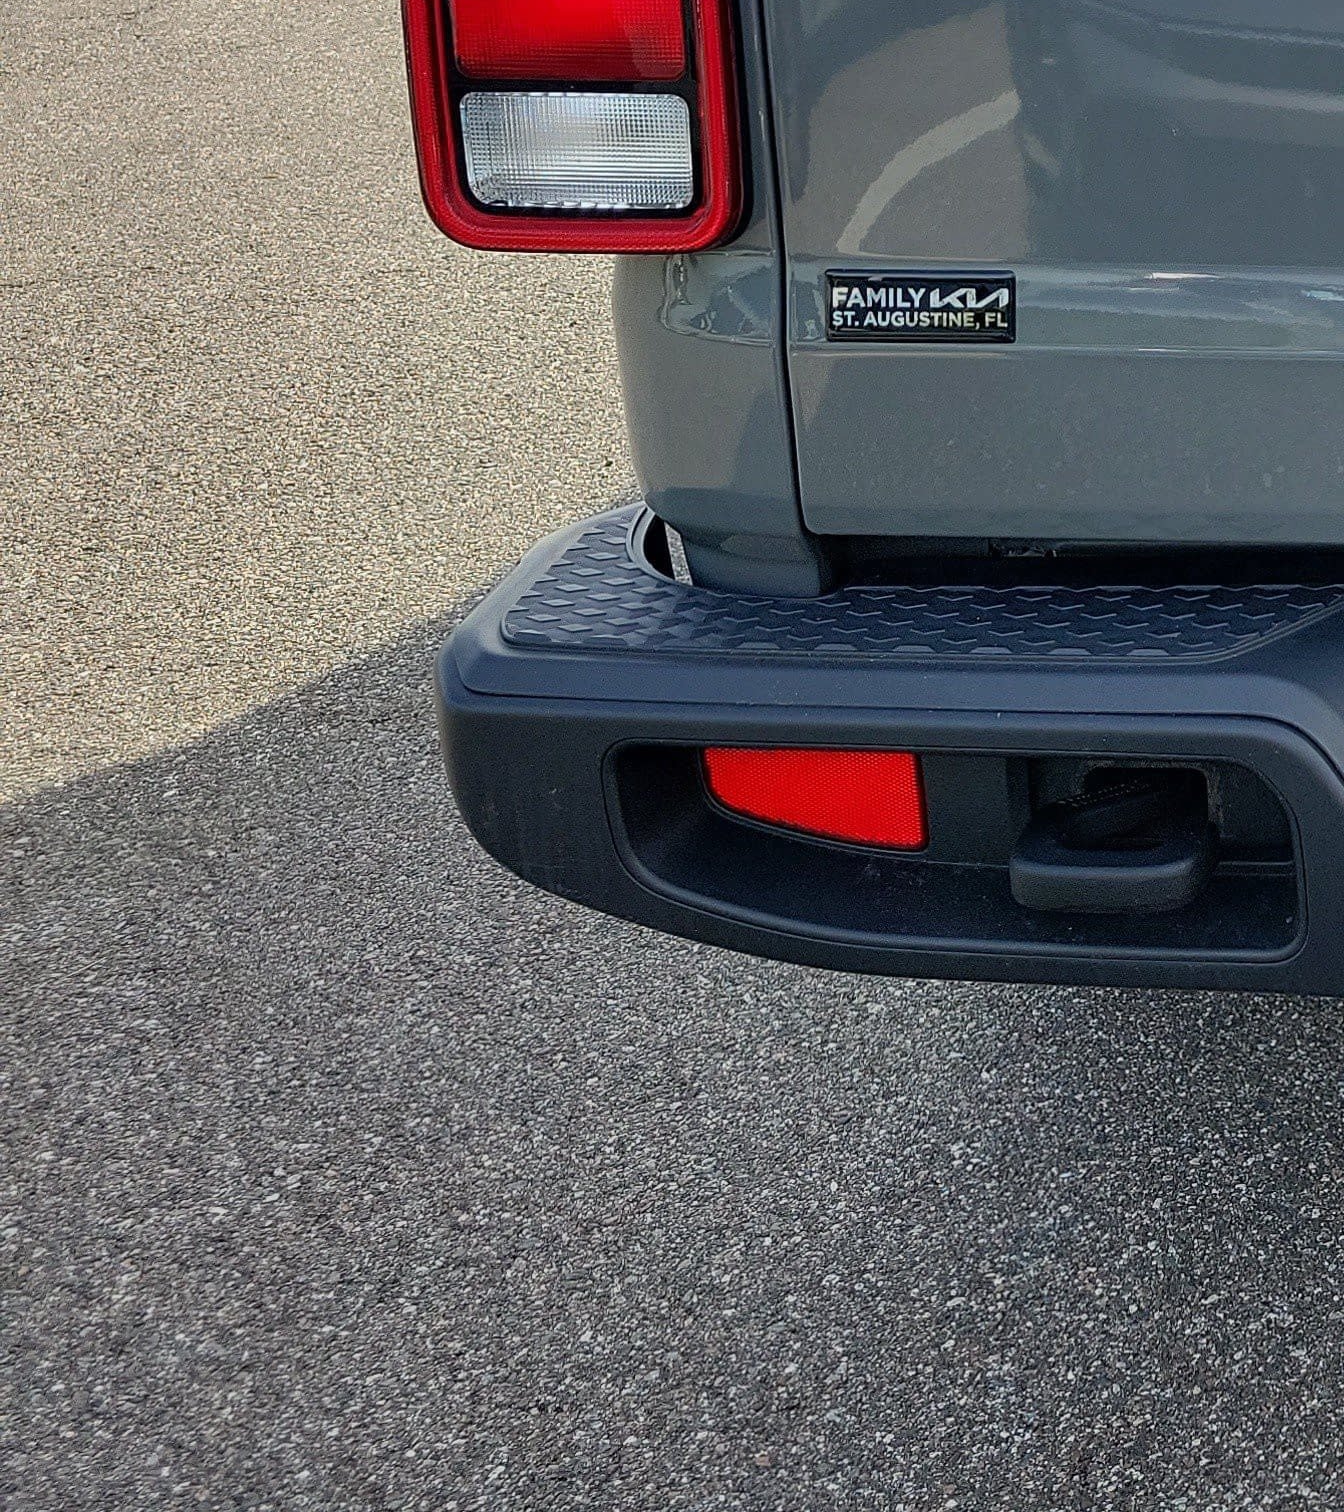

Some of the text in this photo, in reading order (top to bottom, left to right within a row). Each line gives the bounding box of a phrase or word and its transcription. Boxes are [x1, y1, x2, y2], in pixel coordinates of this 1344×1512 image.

[832, 287, 926, 308] FAMILY
[832, 310, 1009, 330] ST. AUGUSTINE, FL
